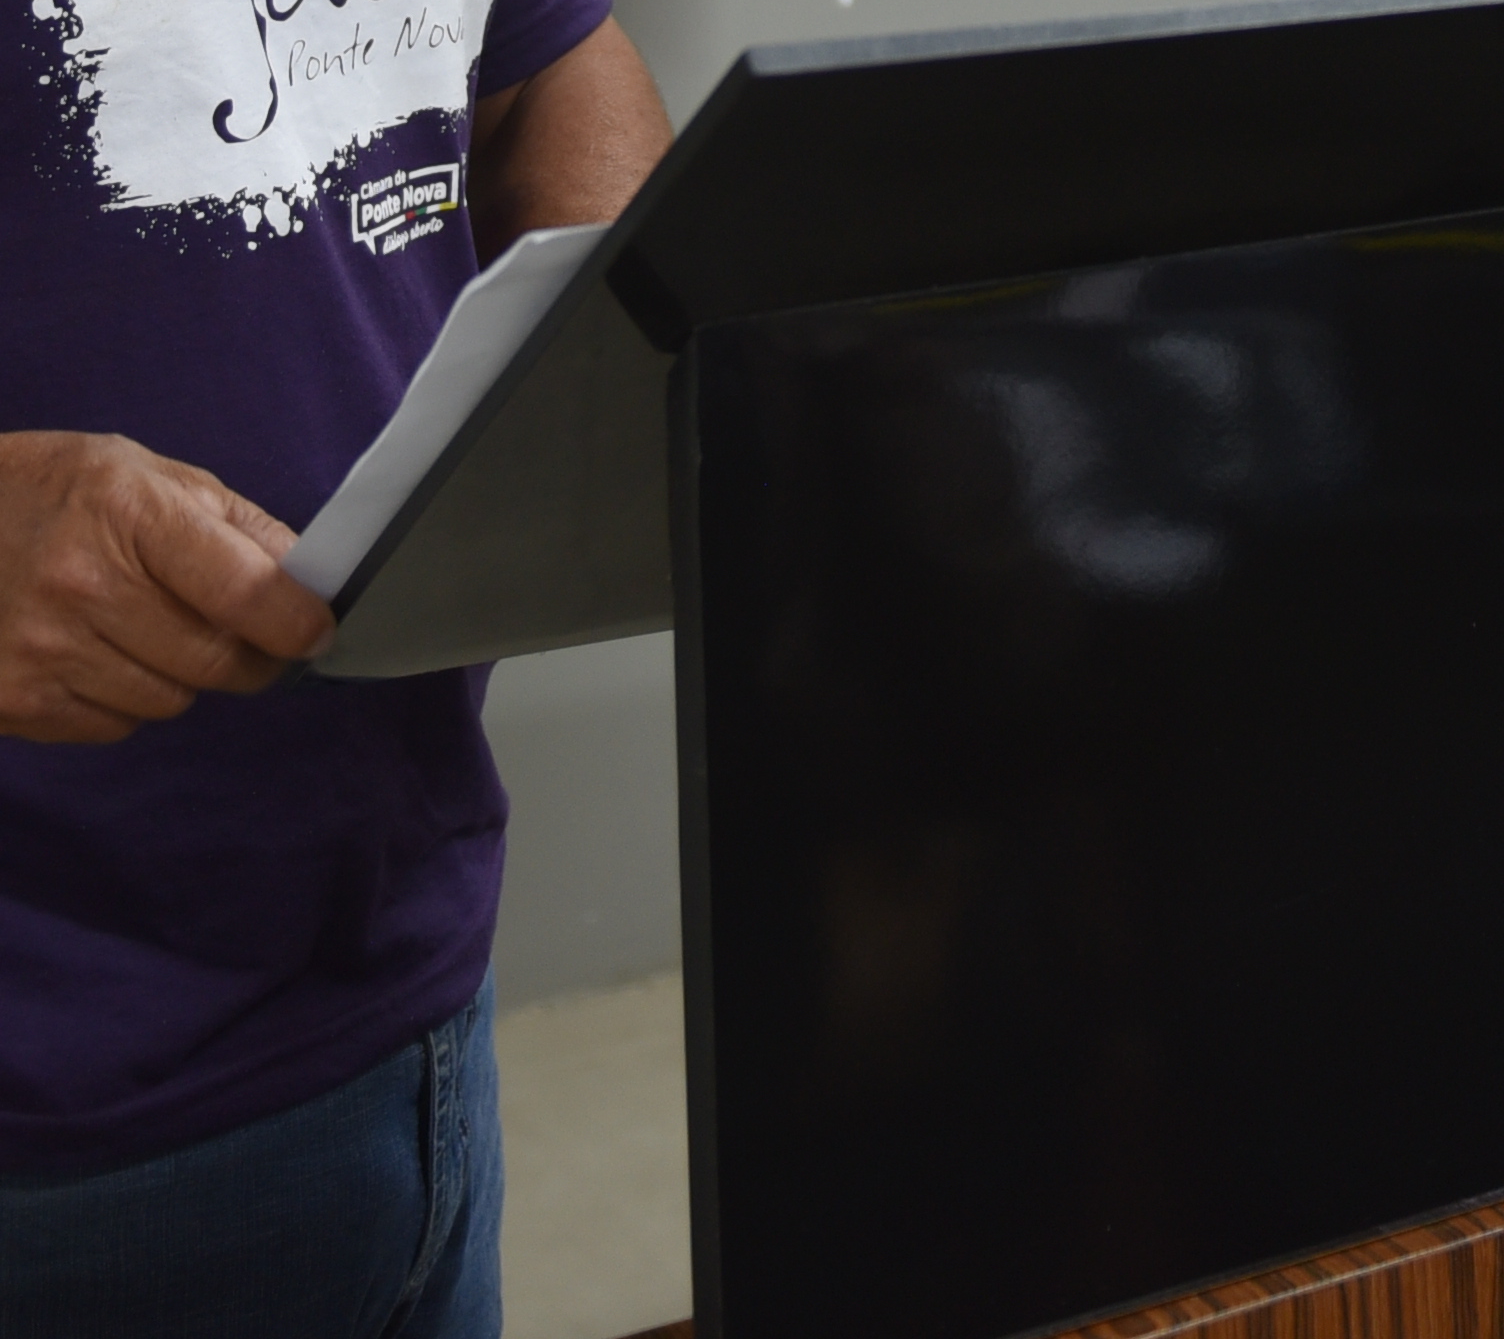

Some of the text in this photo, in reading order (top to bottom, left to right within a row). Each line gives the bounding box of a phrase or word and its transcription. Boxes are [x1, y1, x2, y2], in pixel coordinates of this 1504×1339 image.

[288, 6, 465, 87] Ponte Nov
[361, 181, 448, 228] Ponte Nova
